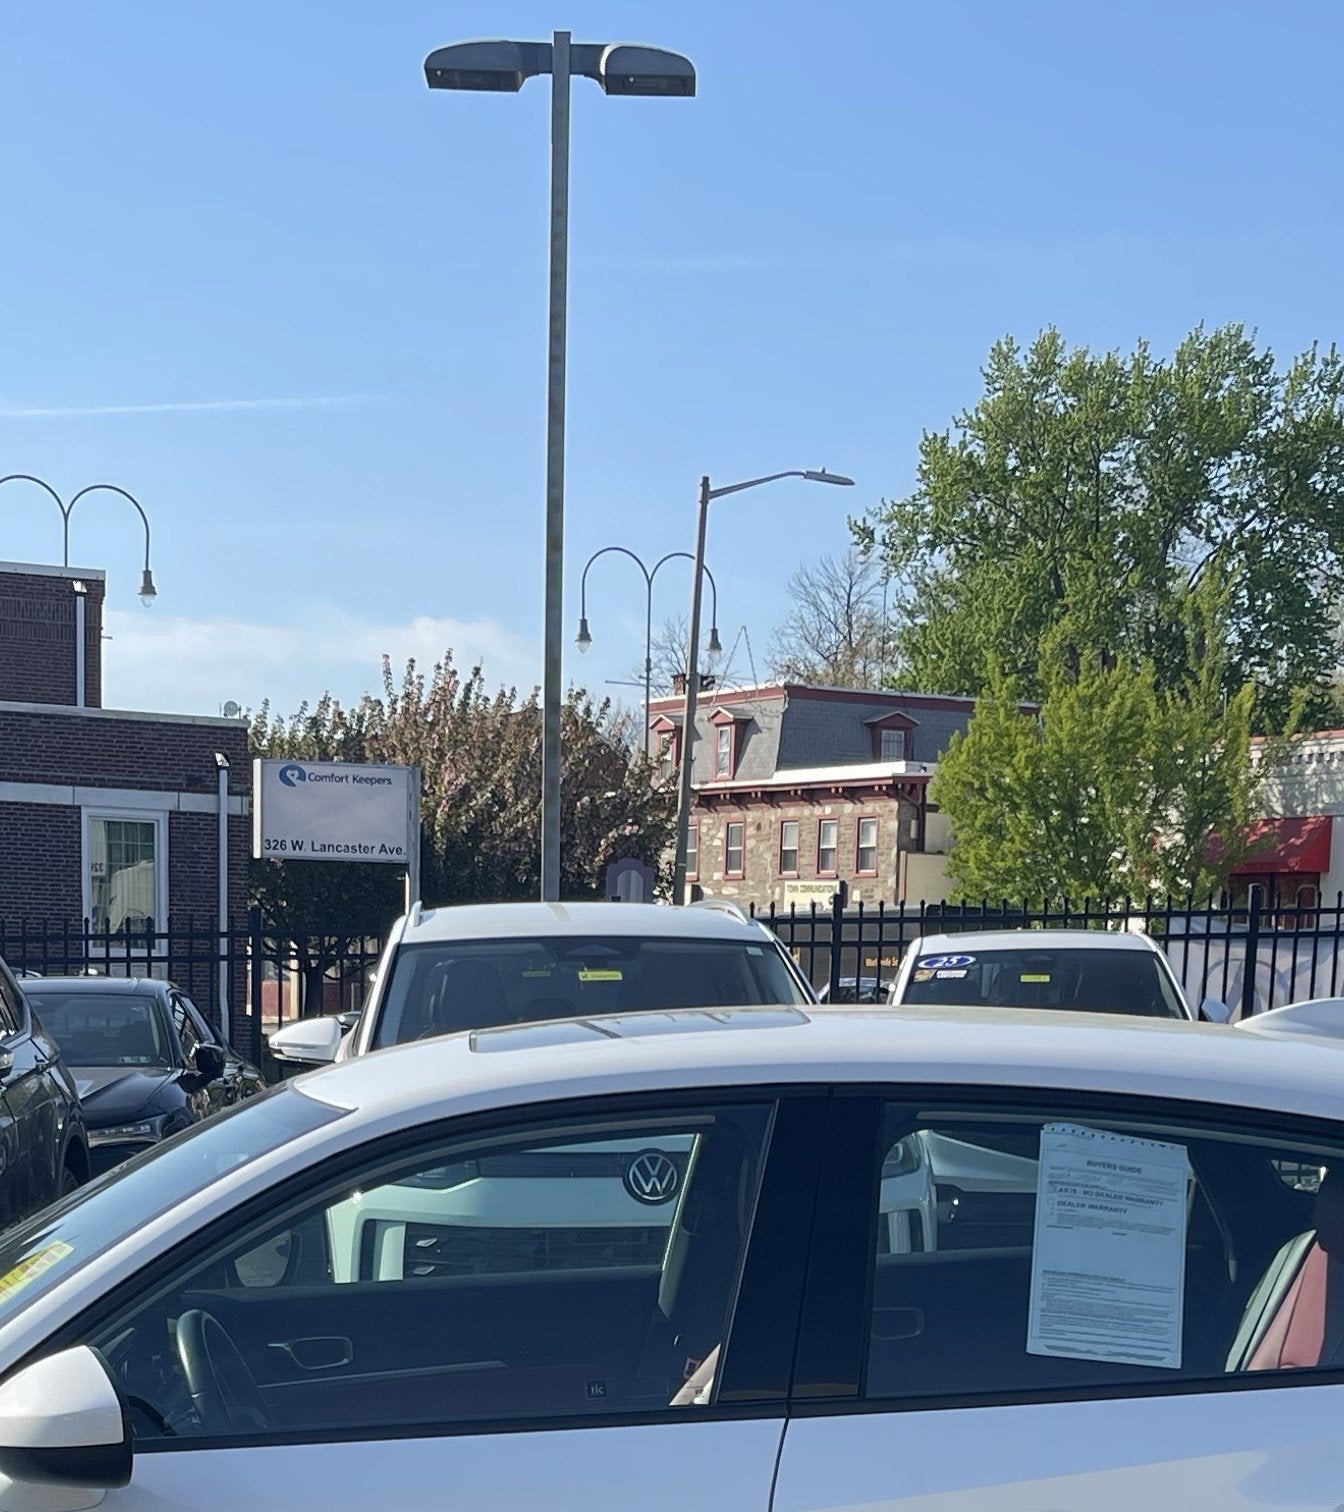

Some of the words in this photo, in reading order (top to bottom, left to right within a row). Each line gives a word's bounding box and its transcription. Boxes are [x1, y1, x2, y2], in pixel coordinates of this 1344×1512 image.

[308, 772, 349, 784] Comfort
[352, 774, 393, 786] Keepers
[264, 839, 287, 851] 326
[311, 840, 375, 855] Lancaster
